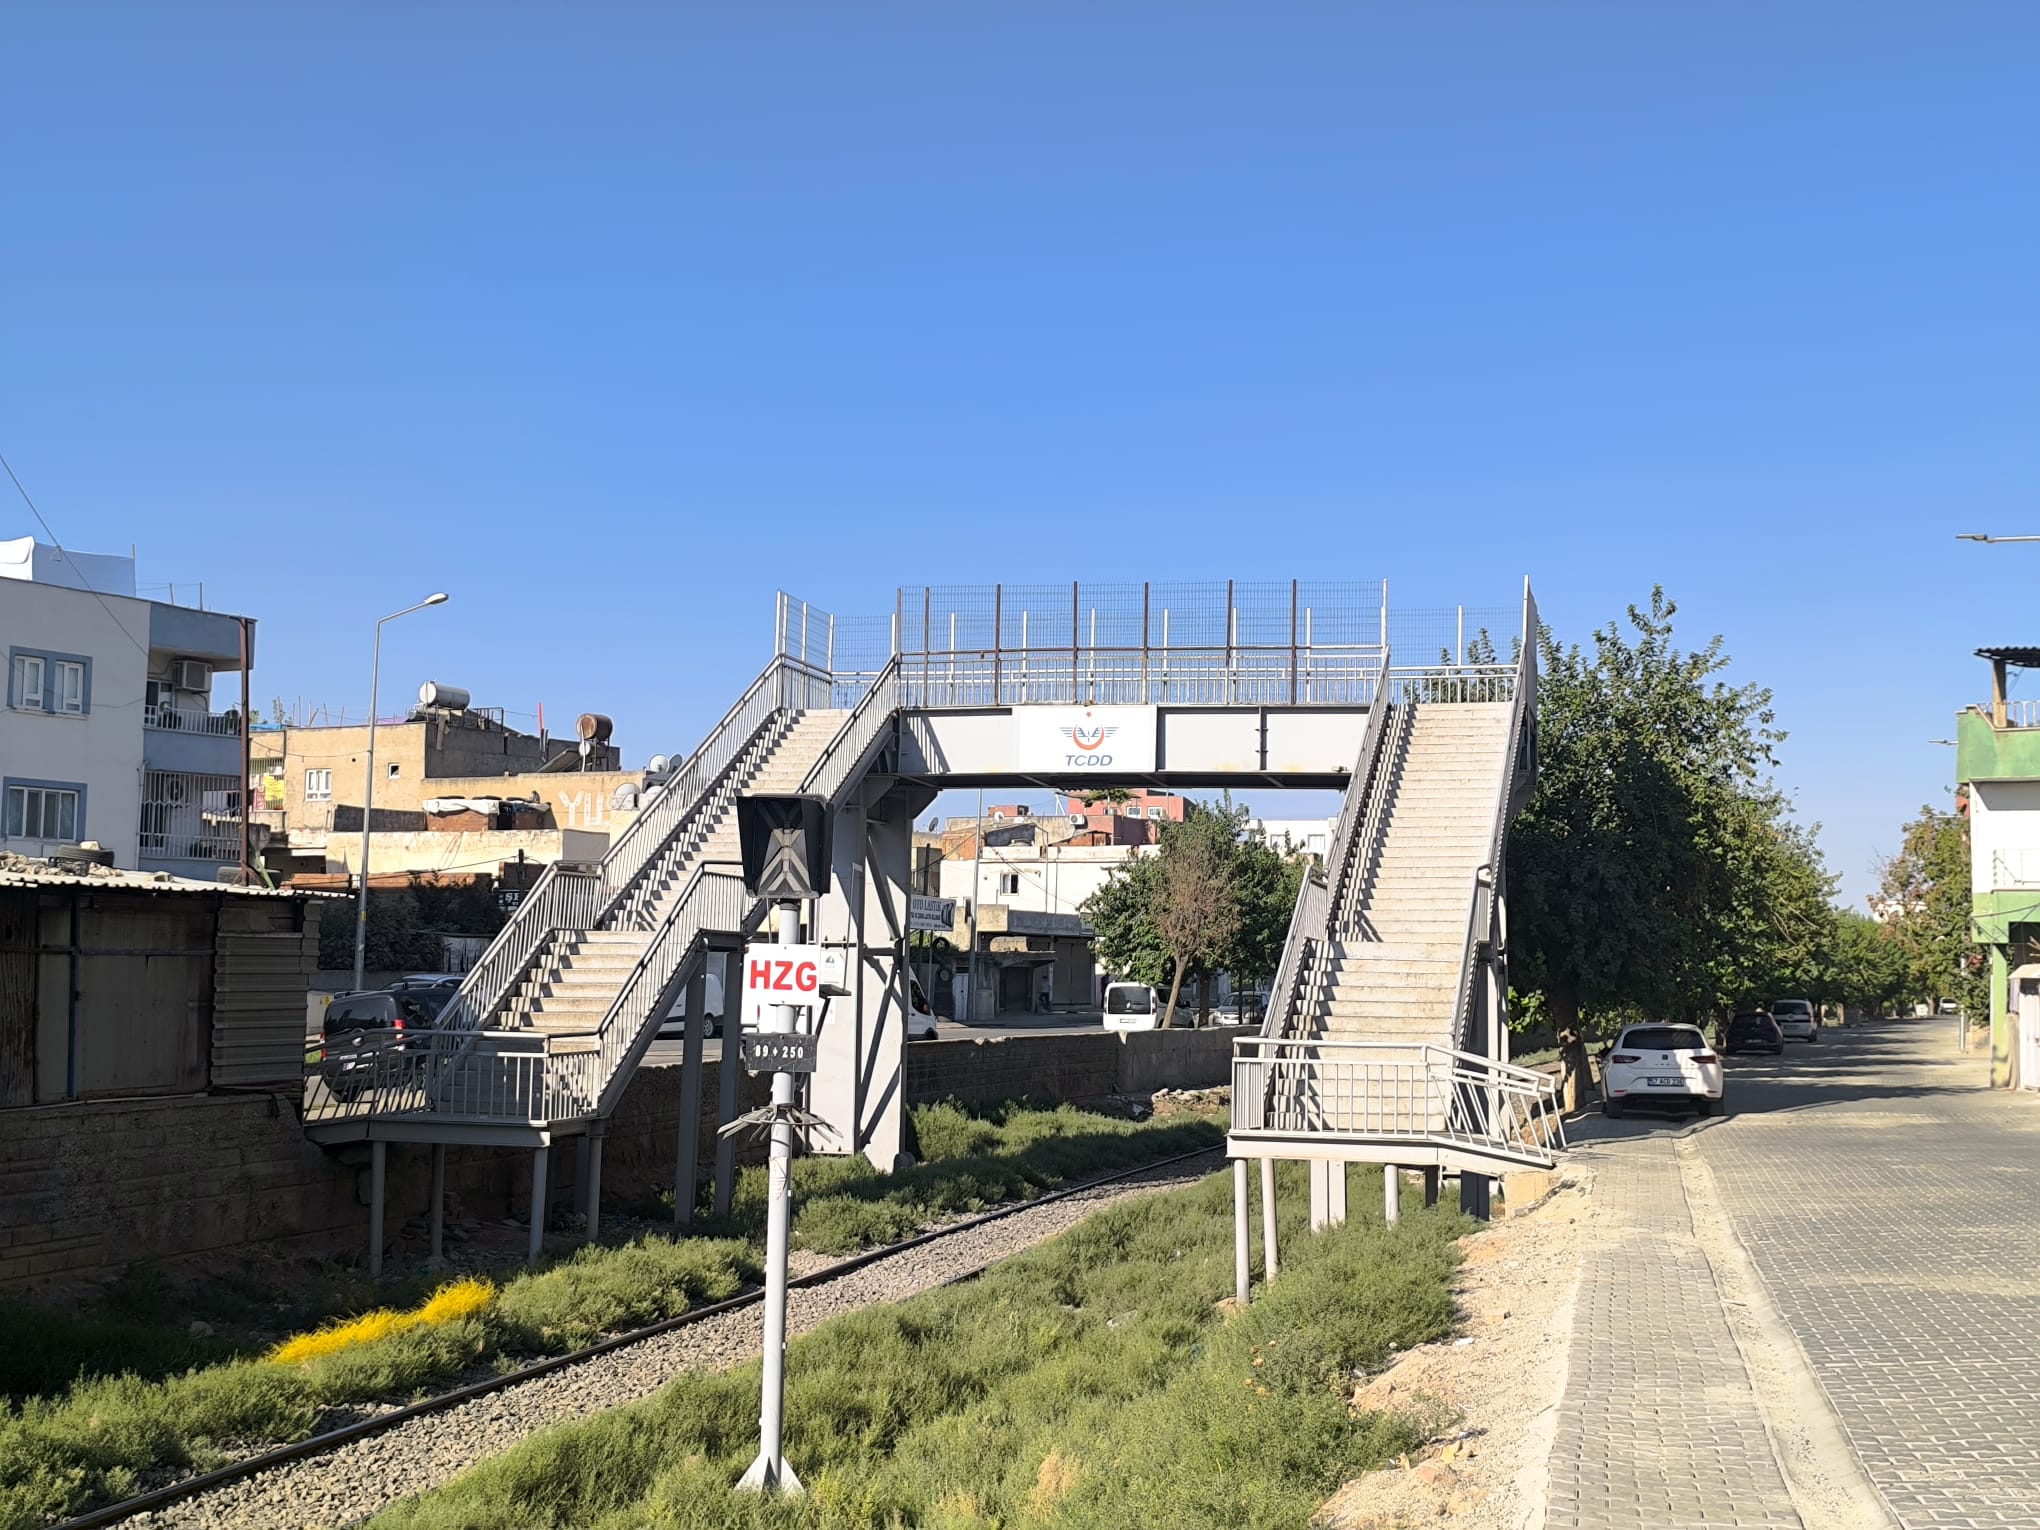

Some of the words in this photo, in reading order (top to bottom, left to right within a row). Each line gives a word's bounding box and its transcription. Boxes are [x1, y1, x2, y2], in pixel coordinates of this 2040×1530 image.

[1065, 754, 1113, 767] TCDD
[912, 898, 923, 909] OTO
[750, 959, 817, 992] HZG
[782, 1045, 804, 1059] 250
